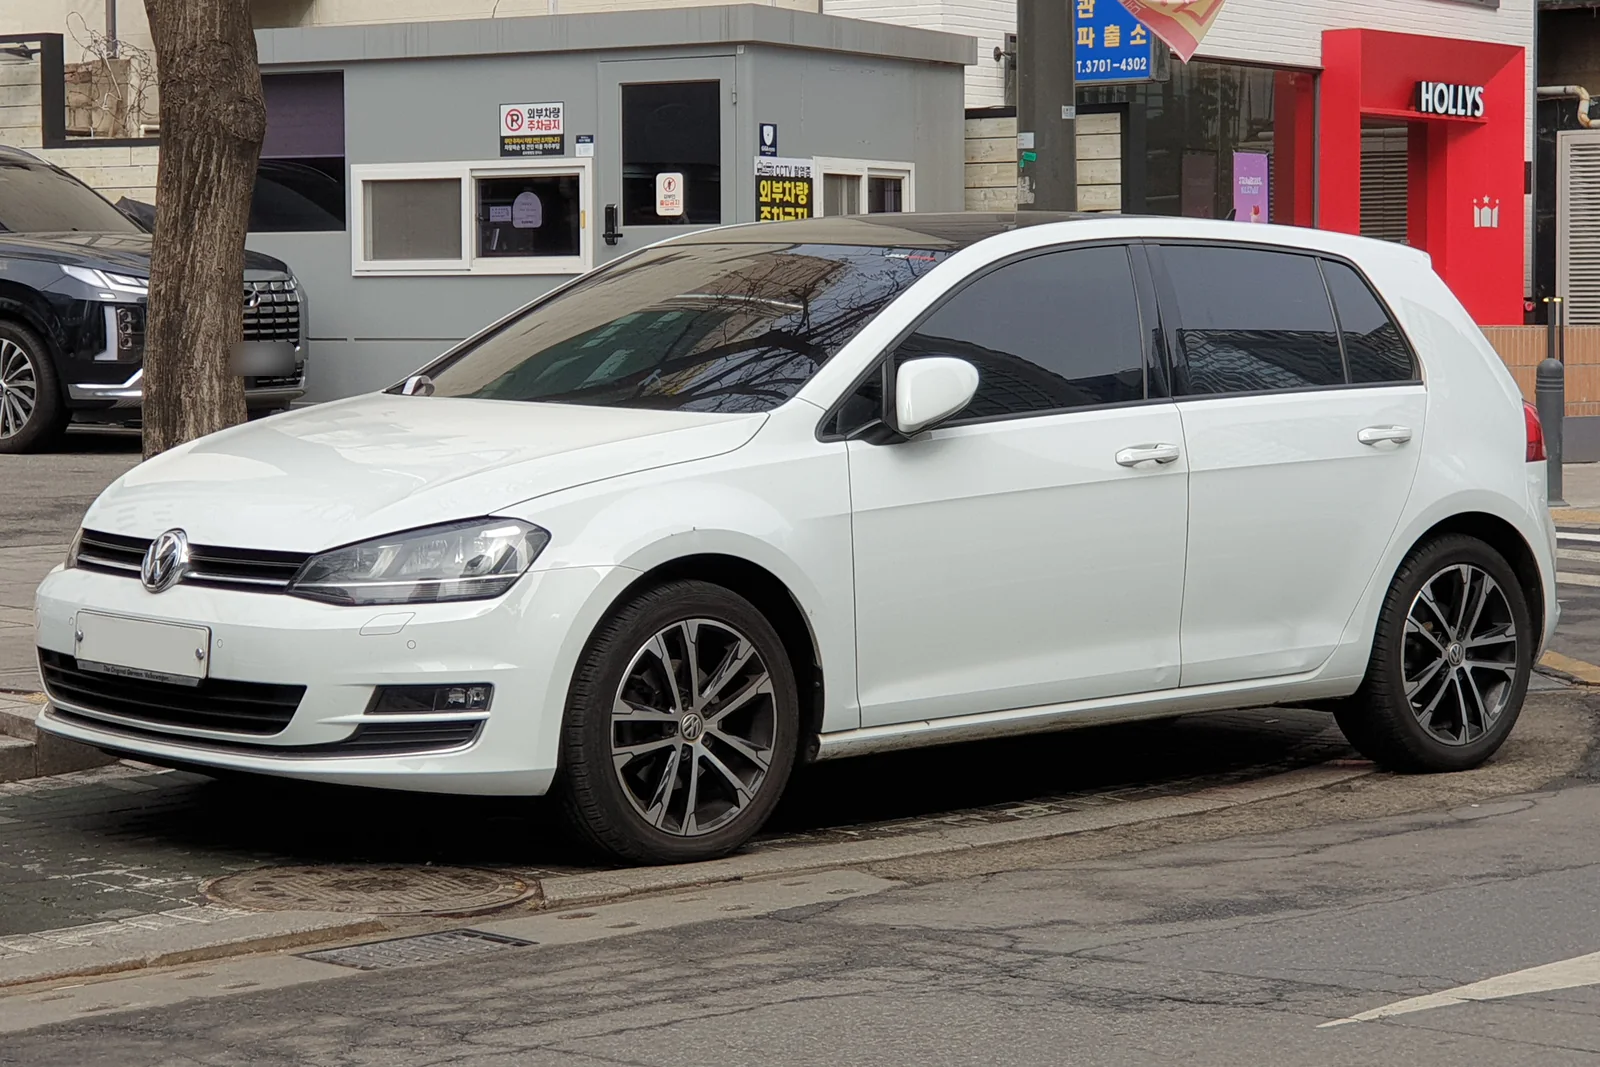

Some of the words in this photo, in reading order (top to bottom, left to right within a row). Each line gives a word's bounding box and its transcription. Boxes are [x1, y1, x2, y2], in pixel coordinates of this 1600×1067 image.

[1076, 57, 1147, 73] T.3701-4302
[1421, 81, 1485, 117] HOLLYS
[527, 107, 560, 119] 외부차량
[527, 119, 561, 131] 주차금지
[775, 165, 793, 177] CCTV
[759, 179, 809, 205] 외부차량
